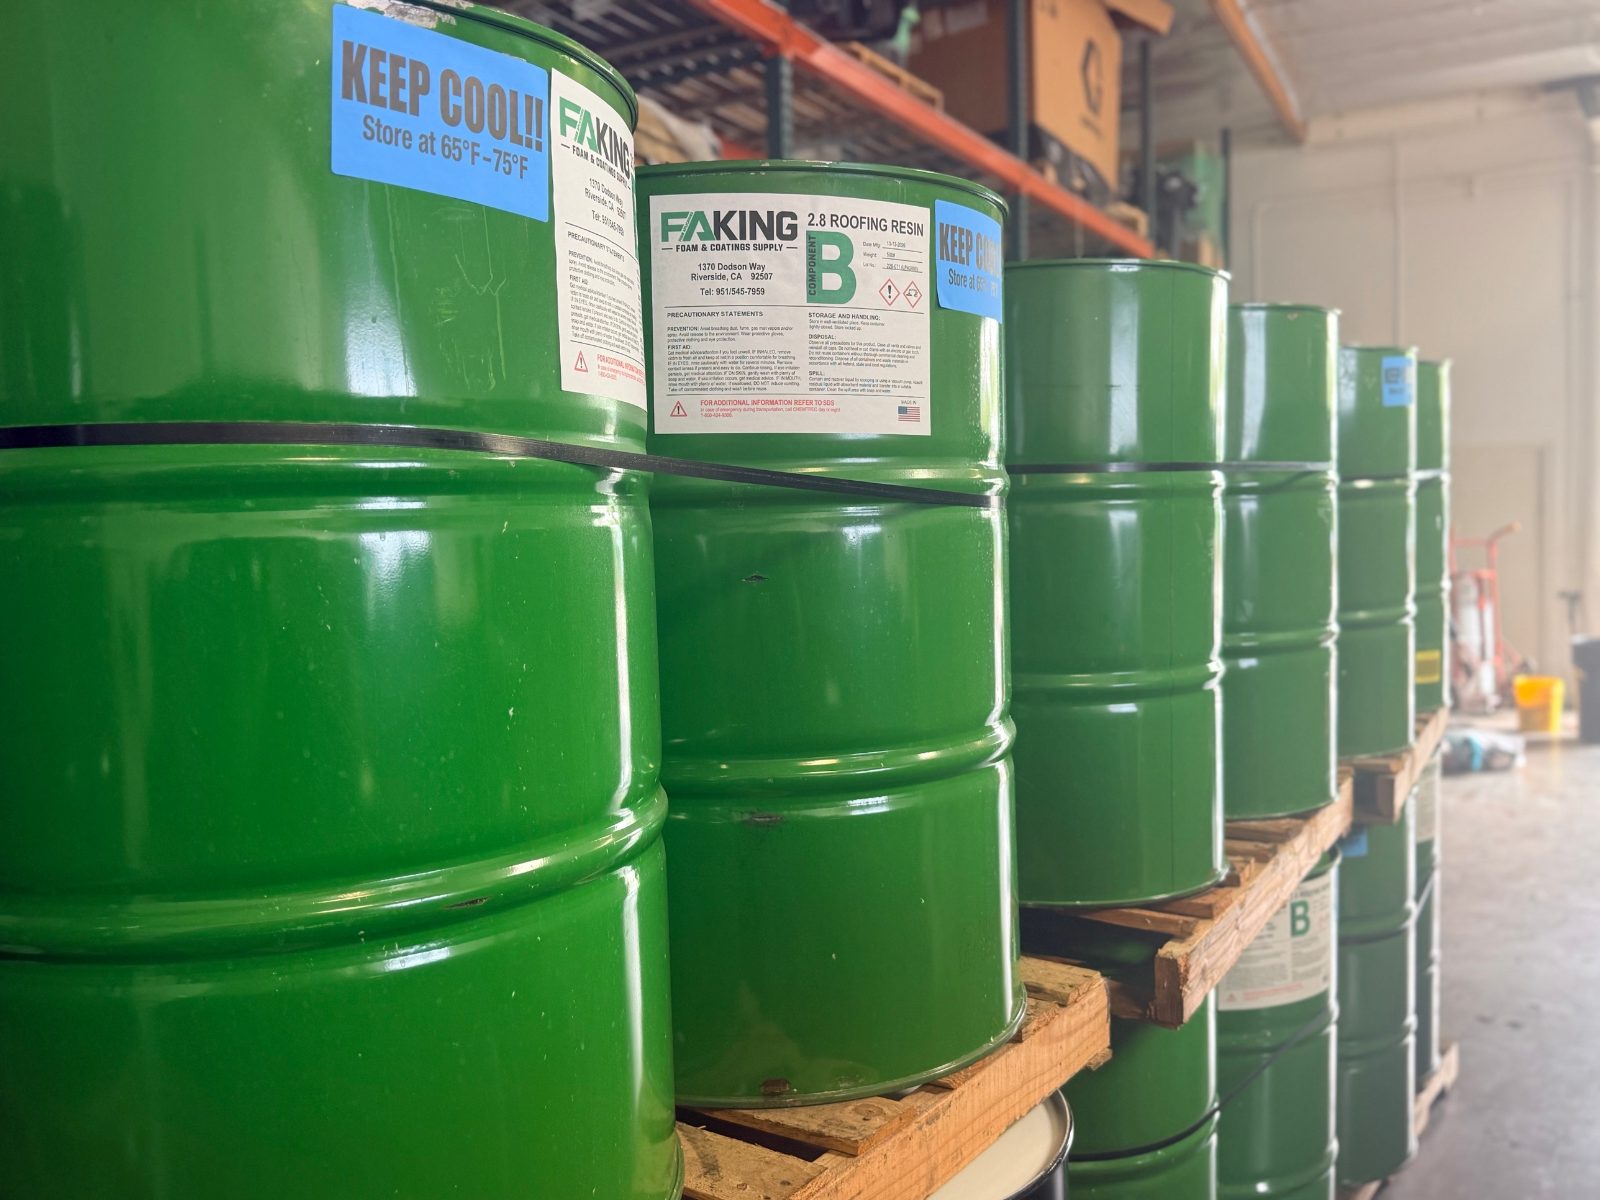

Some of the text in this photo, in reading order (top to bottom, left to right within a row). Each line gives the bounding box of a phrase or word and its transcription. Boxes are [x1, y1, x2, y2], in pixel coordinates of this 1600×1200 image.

[342, 40, 543, 152] KEEP COOL!!
[362, 114, 412, 150] Store
[418, 130, 436, 156] at
[572, 144, 588, 160] FOAM
[808, 213, 924, 236] 2.8 ROOFING RESIN
[940, 222, 973, 266] KEEP
[691, 273, 729, 281] Riverside,
[749, 263, 765, 272] Way
[806, 230, 856, 304] B
[808, 235, 816, 296] COMPONENT
[948, 268, 967, 288] Store
[1290, 900, 1310, 938] B
